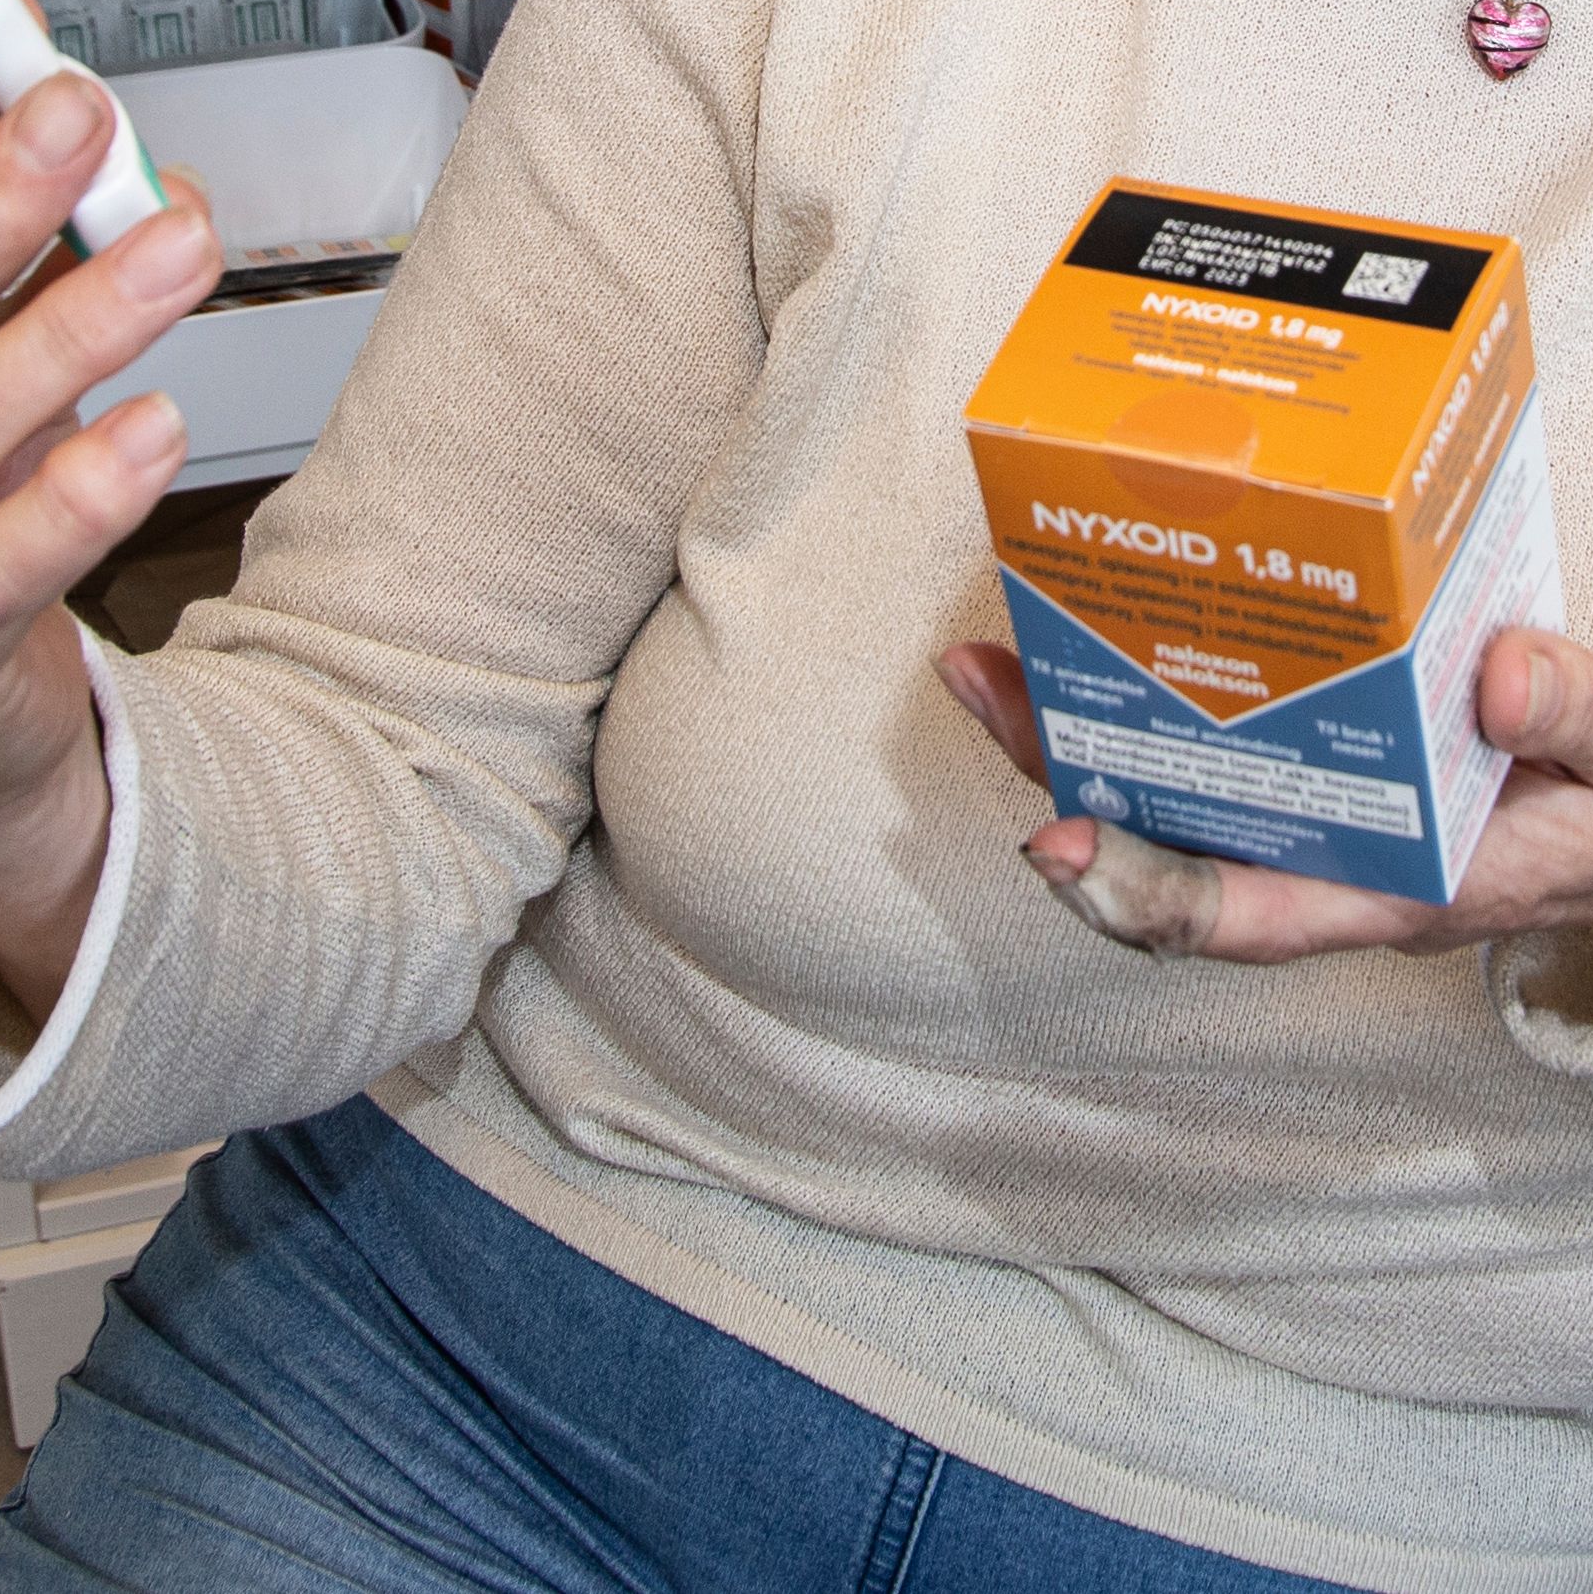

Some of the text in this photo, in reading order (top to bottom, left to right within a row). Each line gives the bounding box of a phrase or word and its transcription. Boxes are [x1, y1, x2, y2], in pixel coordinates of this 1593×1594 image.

[1141, 292, 1345, 351] NYXOID 1,8 mg
[1412, 372, 1472, 497] NYXOID
[1030, 499, 1359, 604] NYXOID 1,8 mg
[1152, 660, 1270, 699] nalokson
[1154, 642, 1260, 678] naloxon
